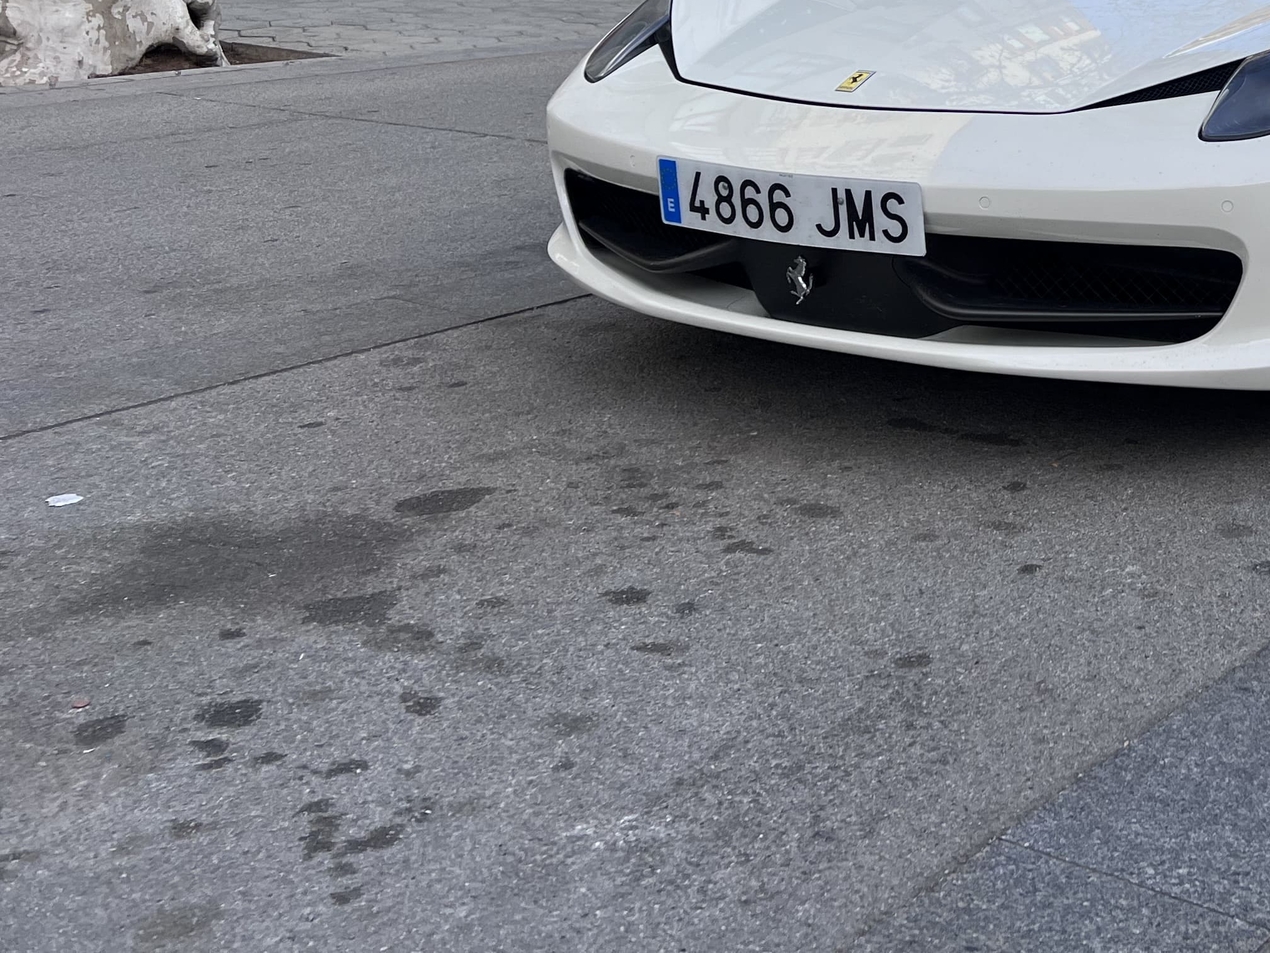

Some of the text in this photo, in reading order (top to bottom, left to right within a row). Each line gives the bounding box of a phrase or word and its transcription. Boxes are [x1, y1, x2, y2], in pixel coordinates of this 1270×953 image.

[667, 198, 675, 212] E
[689, 171, 909, 243] 4866 JMS
